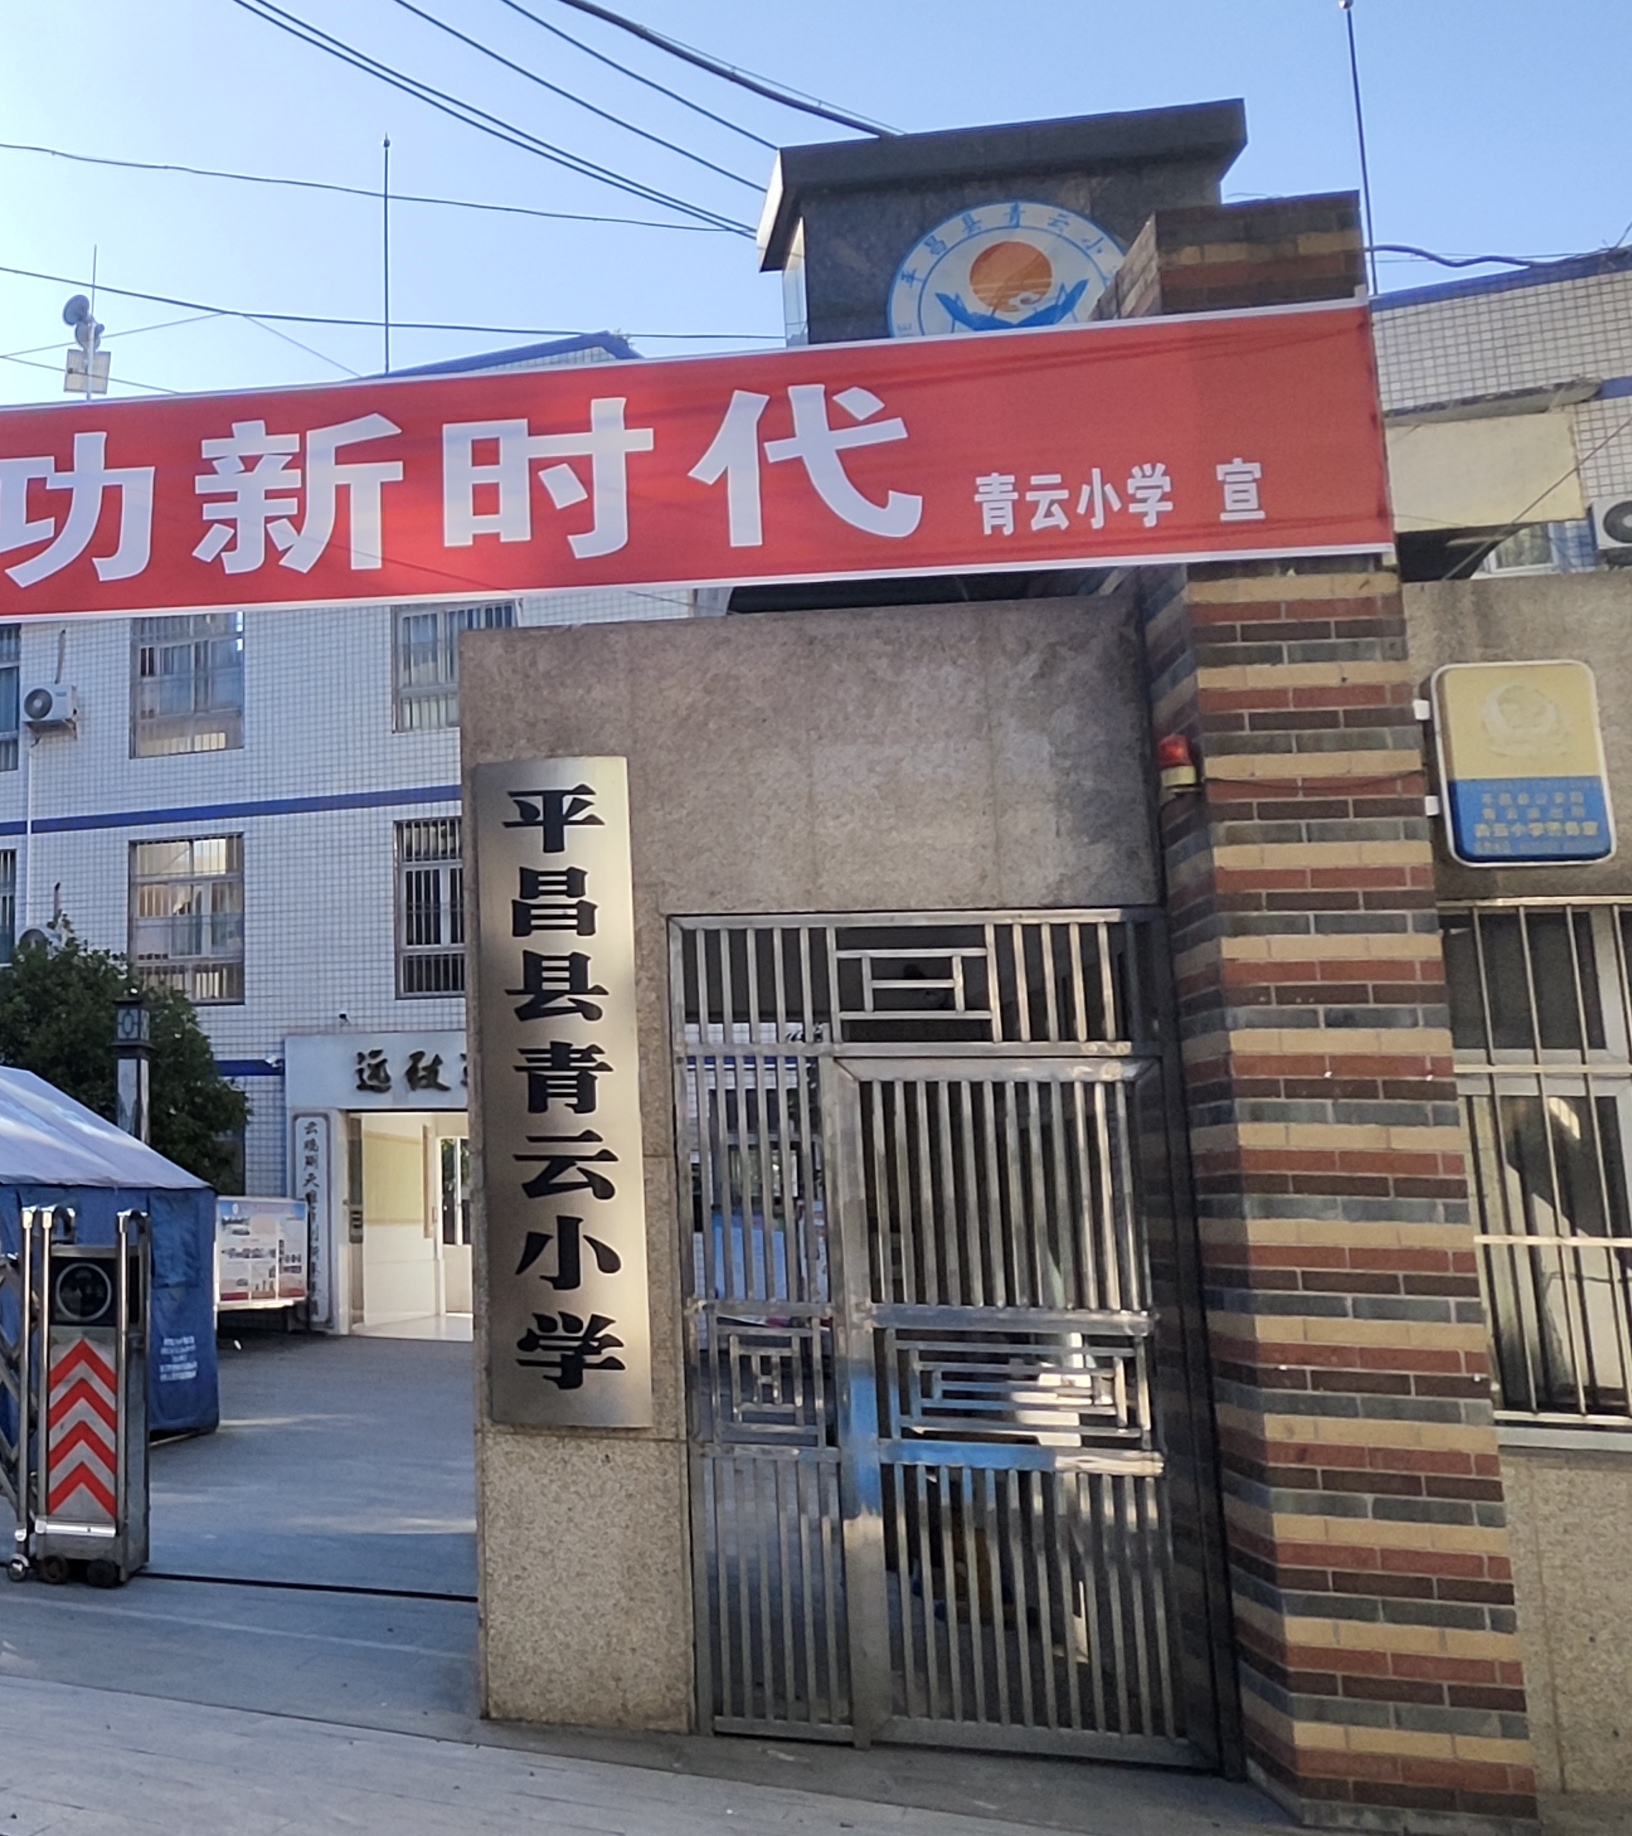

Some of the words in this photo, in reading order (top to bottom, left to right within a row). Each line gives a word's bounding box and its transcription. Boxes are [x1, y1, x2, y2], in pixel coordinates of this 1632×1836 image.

[900, 201, 1118, 288] 平昌县青云小
[974, 462, 1174, 536] 青云小学
[1215, 457, 1266, 522] 宣
[355, 1048, 467, 1094] 远致
[501, 782, 627, 1391] 平昌县青云小学
